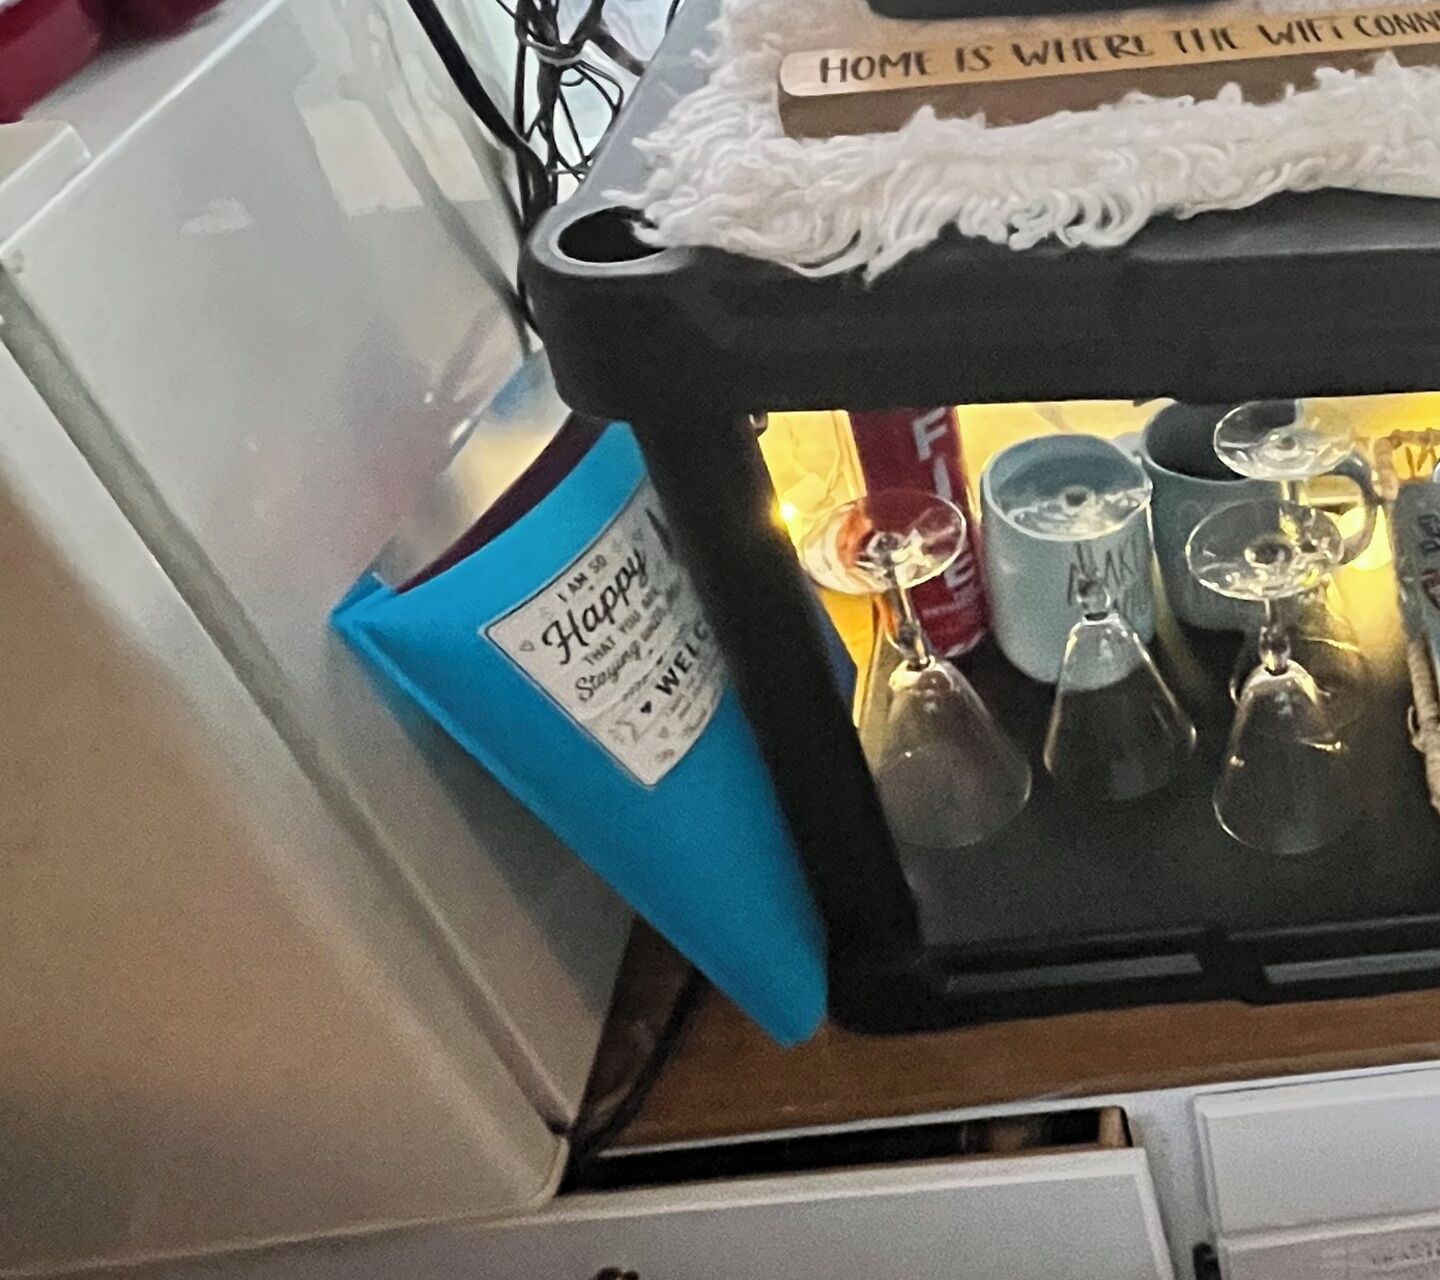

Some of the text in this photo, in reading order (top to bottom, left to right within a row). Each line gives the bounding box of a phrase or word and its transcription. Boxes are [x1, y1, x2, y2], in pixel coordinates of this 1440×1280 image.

[819, 50, 931, 86] HOME
[955, 44, 994, 74] IS
[1012, 31, 1153, 68] WHERE
[1171, 25, 1239, 55] THE
[567, 572, 589, 594] AM
[588, 553, 607, 574] SO
[541, 547, 649, 666] Happy
[583, 635, 617, 667] THAT
[619, 610, 643, 636] YOU
[655, 620, 711, 697] WELC
[574, 639, 643, 703] Staying
